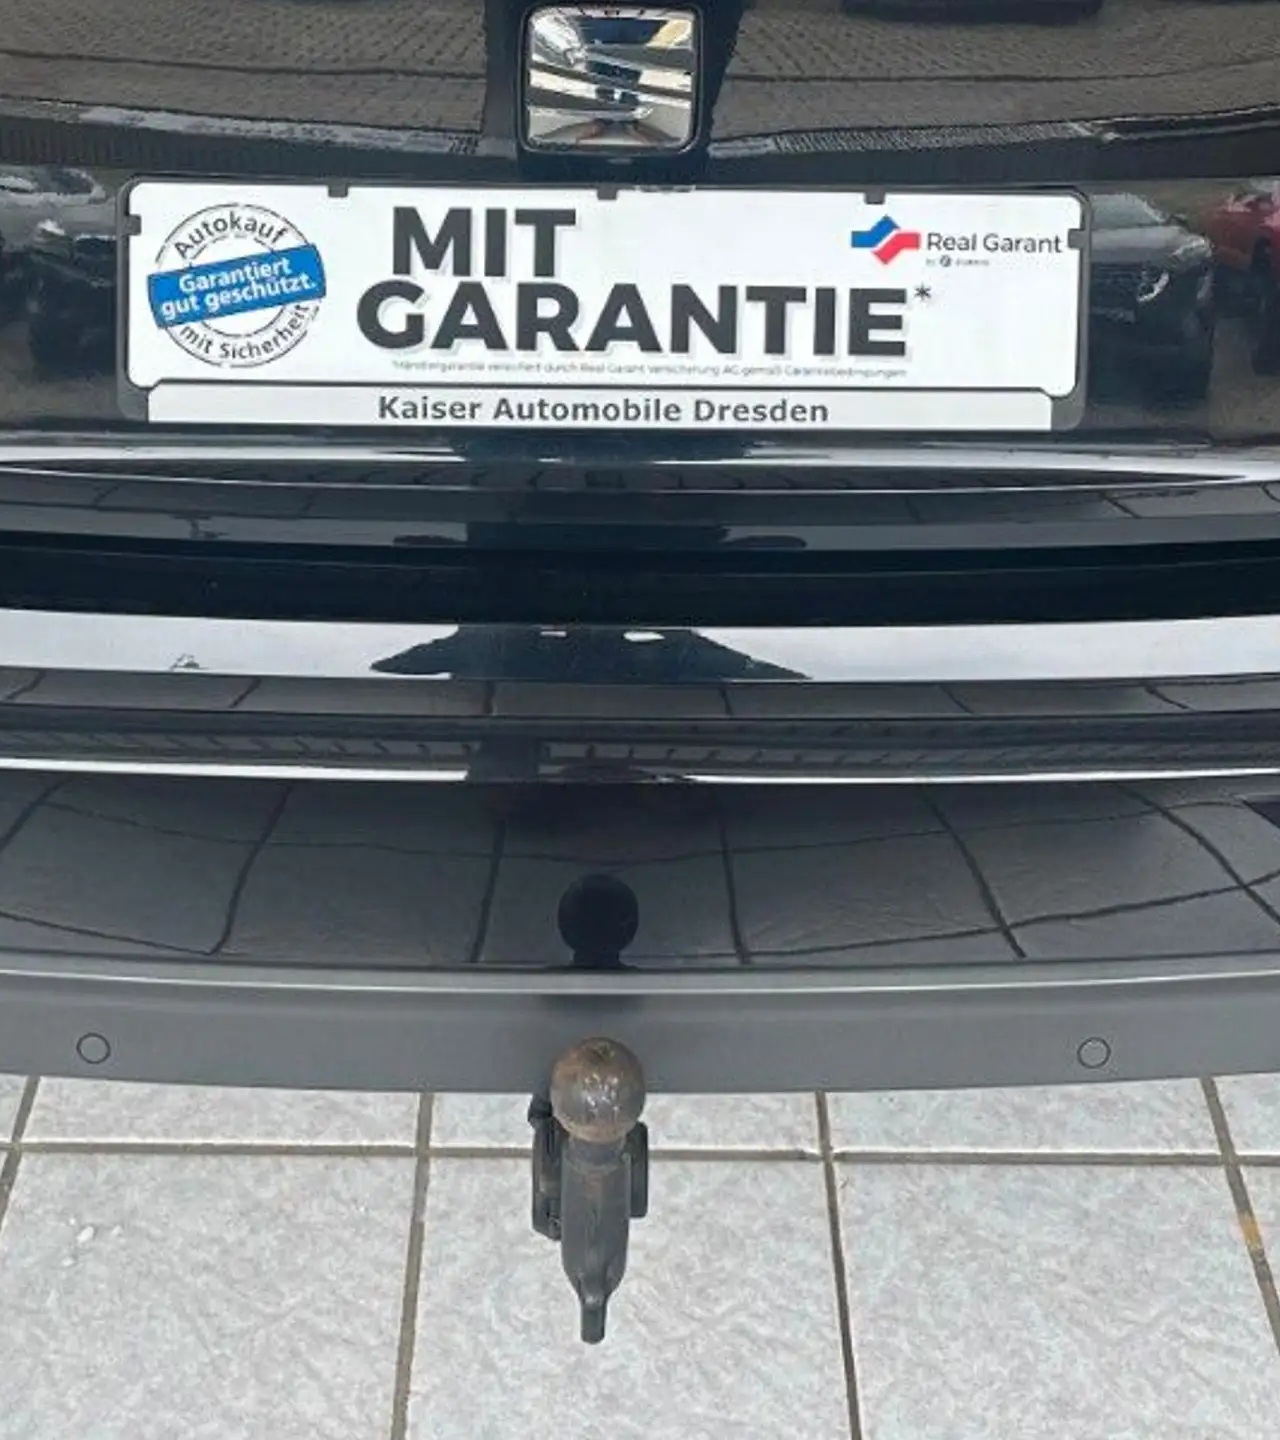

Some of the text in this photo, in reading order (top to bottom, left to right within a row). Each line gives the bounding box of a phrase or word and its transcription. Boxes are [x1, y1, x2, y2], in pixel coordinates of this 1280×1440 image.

[173, 211, 289, 260] Autokauf
[393, 206, 577, 278] MIT
[926, 232, 1062, 254] Real Garant
[160, 271, 318, 321] gut geschützt.
[178, 257, 292, 293] Garantiert
[179, 303, 311, 360] mit Sicherheit
[378, 396, 829, 423] Kaiser Automobile Dresden
